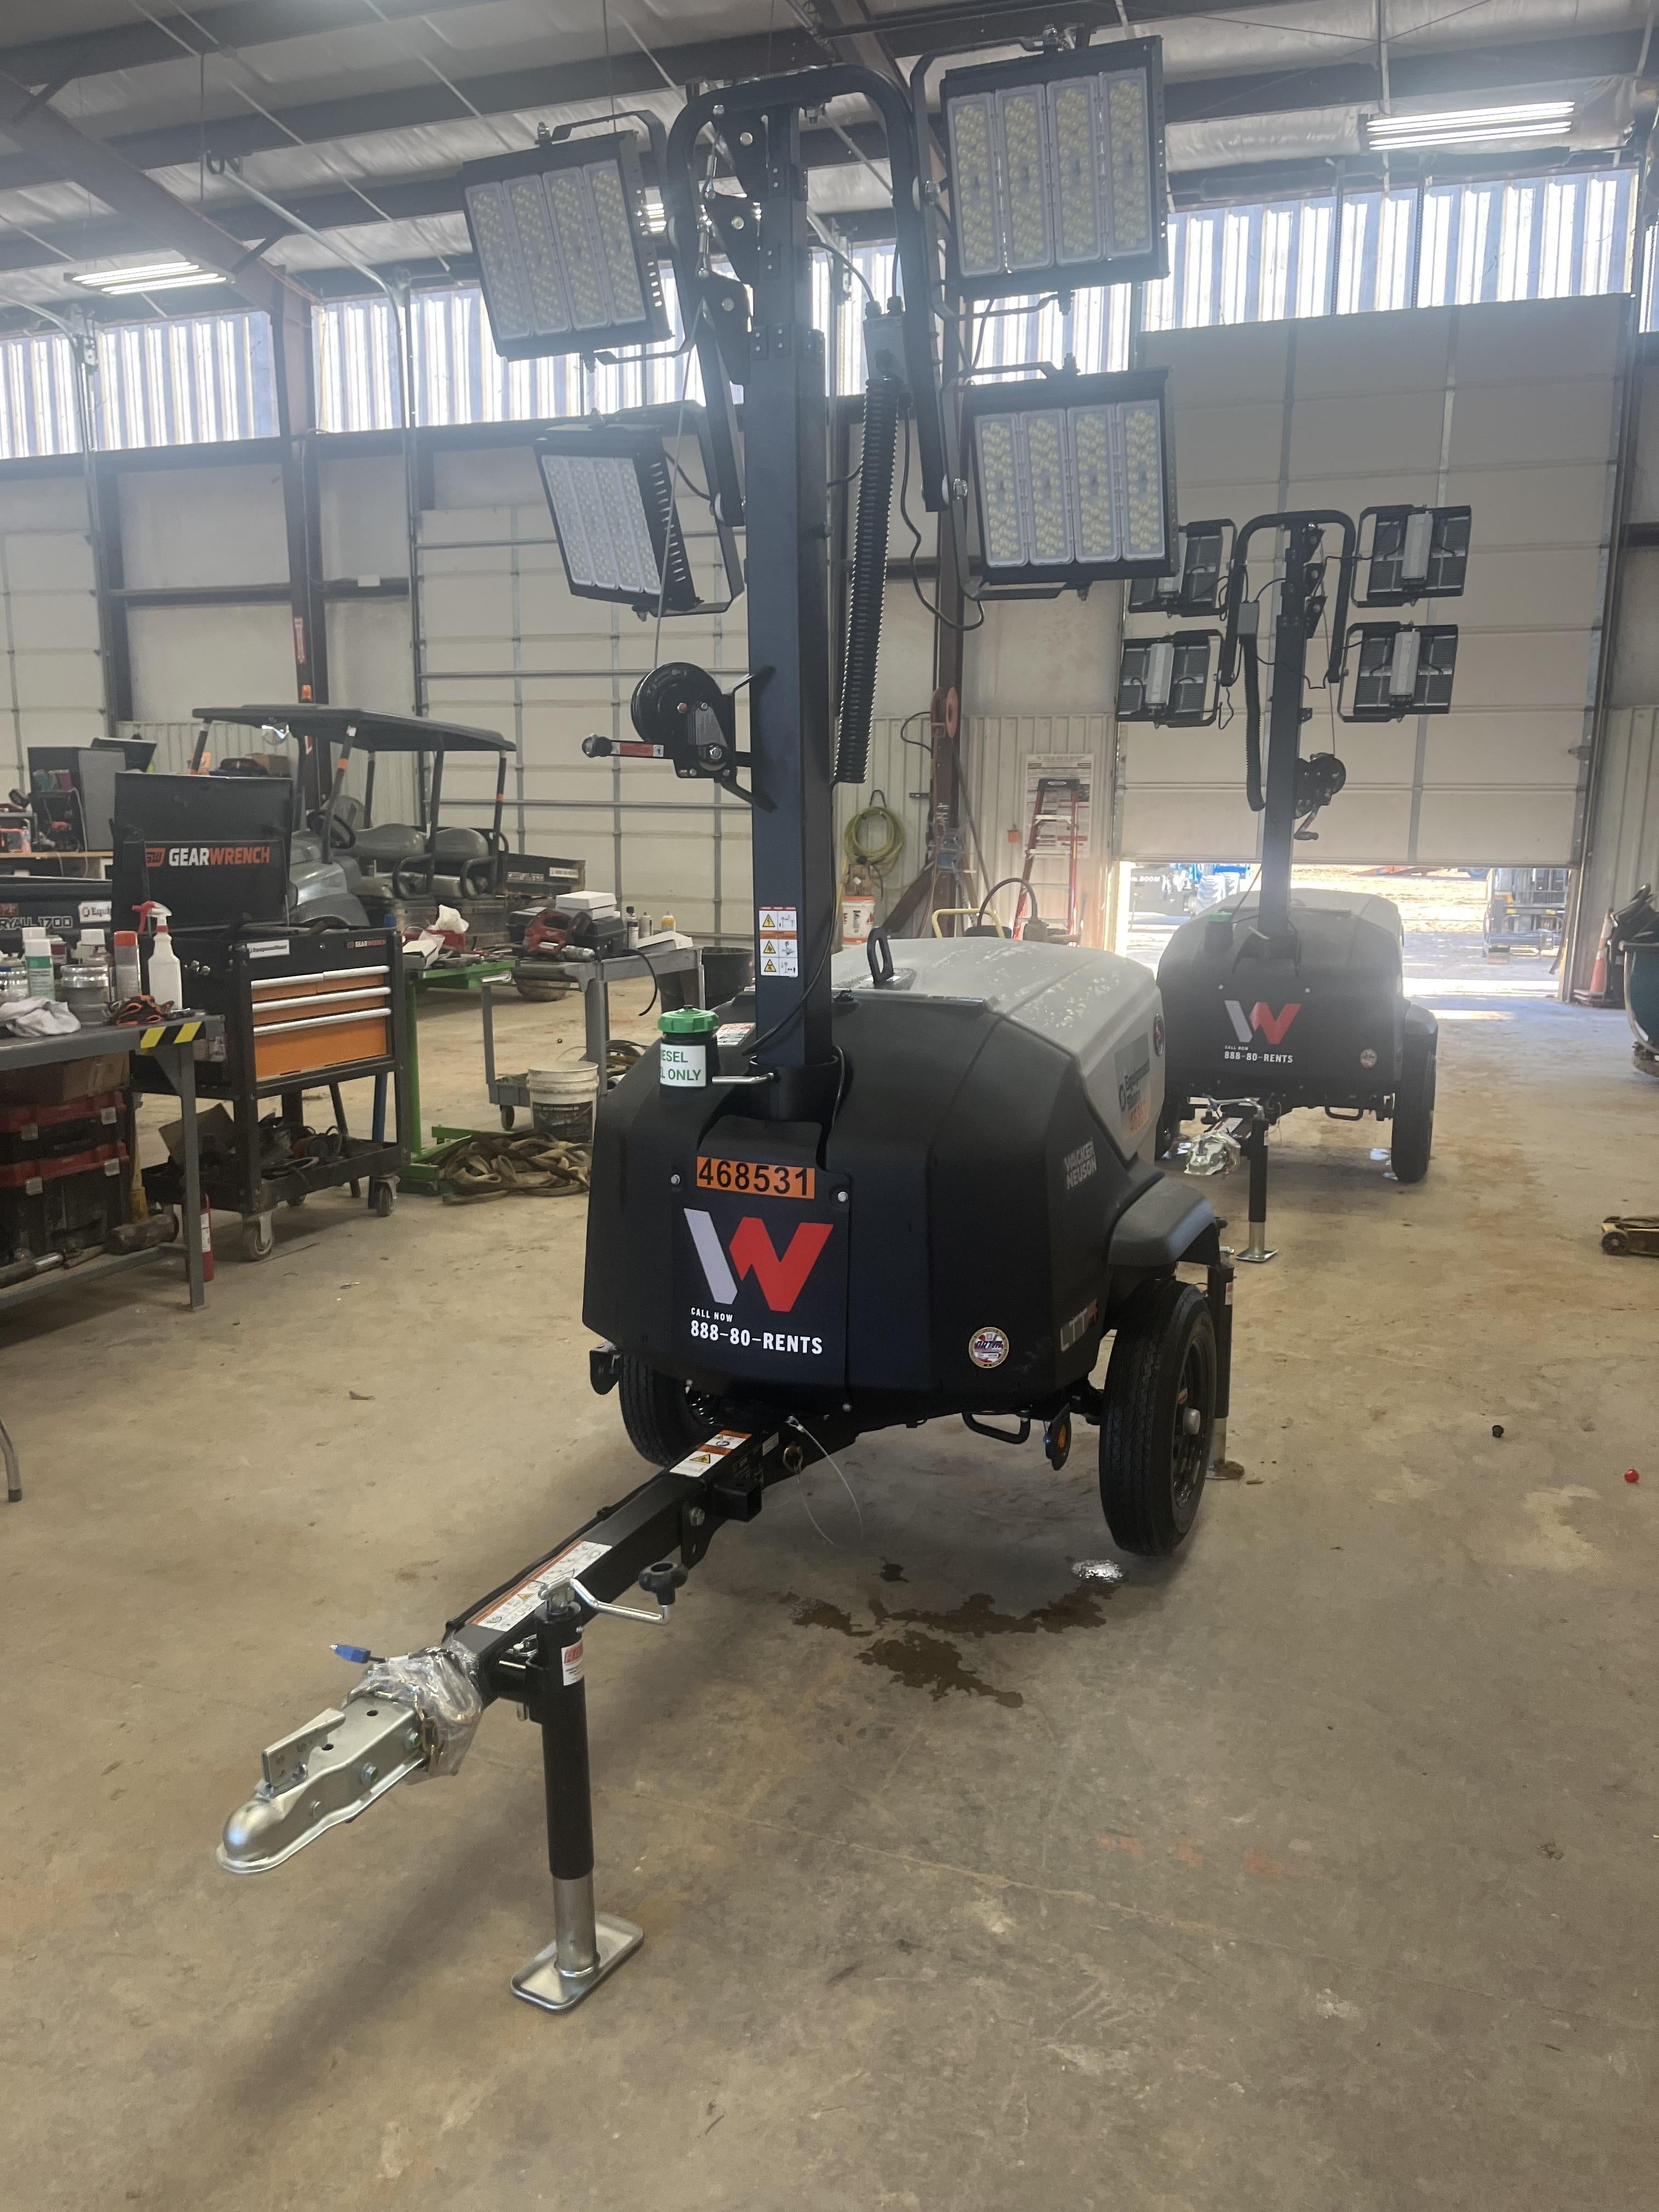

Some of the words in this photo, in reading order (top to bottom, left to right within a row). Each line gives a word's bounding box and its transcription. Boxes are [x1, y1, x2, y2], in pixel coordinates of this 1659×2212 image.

[169, 847, 270, 866] GEARWRENCH
[38, 916, 73, 929] 1700
[1224, 1051, 1294, 1063] 888-80-RENTS
[668, 1068, 702, 1081] ONLY
[1064, 1139, 1095, 1173] WACKER
[698, 1158, 809, 1197] 468531
[1066, 1154, 1097, 1190] NEUSON
[691, 1307, 710, 1319] CALL
[714, 1311, 733, 1323] NOW
[691, 1320, 823, 1355] 888-80-RENTS
